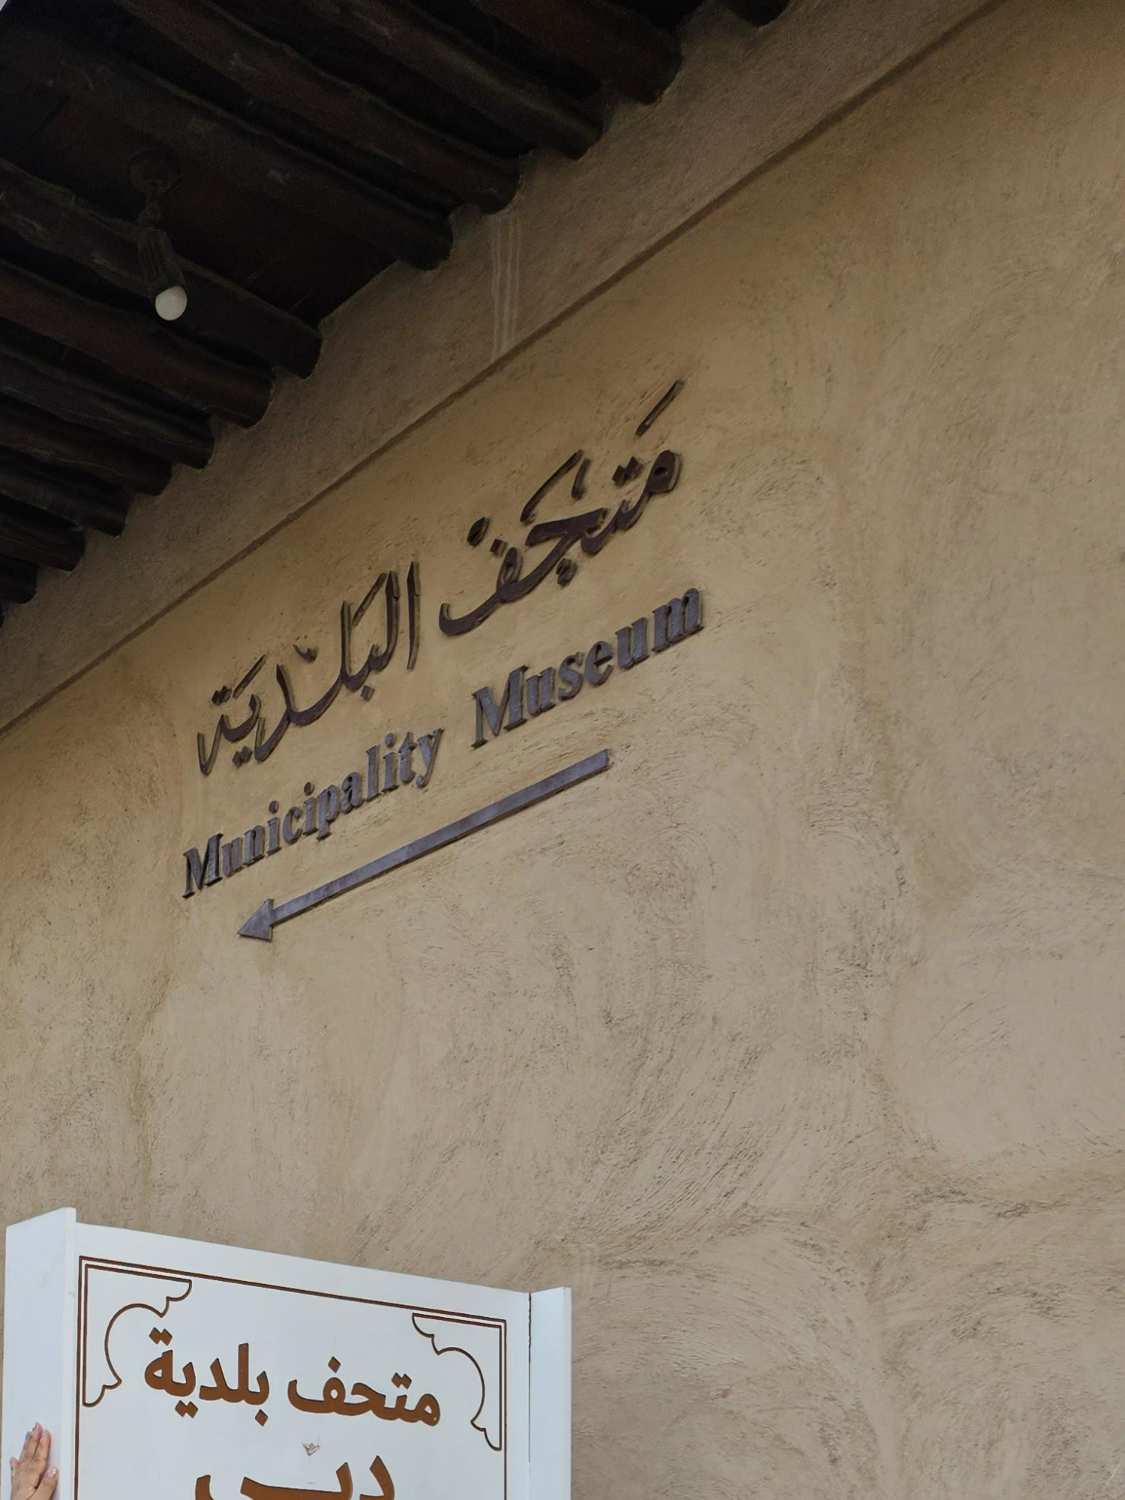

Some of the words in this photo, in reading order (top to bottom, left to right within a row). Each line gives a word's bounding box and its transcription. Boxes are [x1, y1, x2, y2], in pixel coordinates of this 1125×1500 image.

[182, 727, 444, 899] Municipality
[470, 587, 705, 749] Museum
[143, 1326, 270, 1427] بلدية
[286, 1356, 441, 1427] متحف
